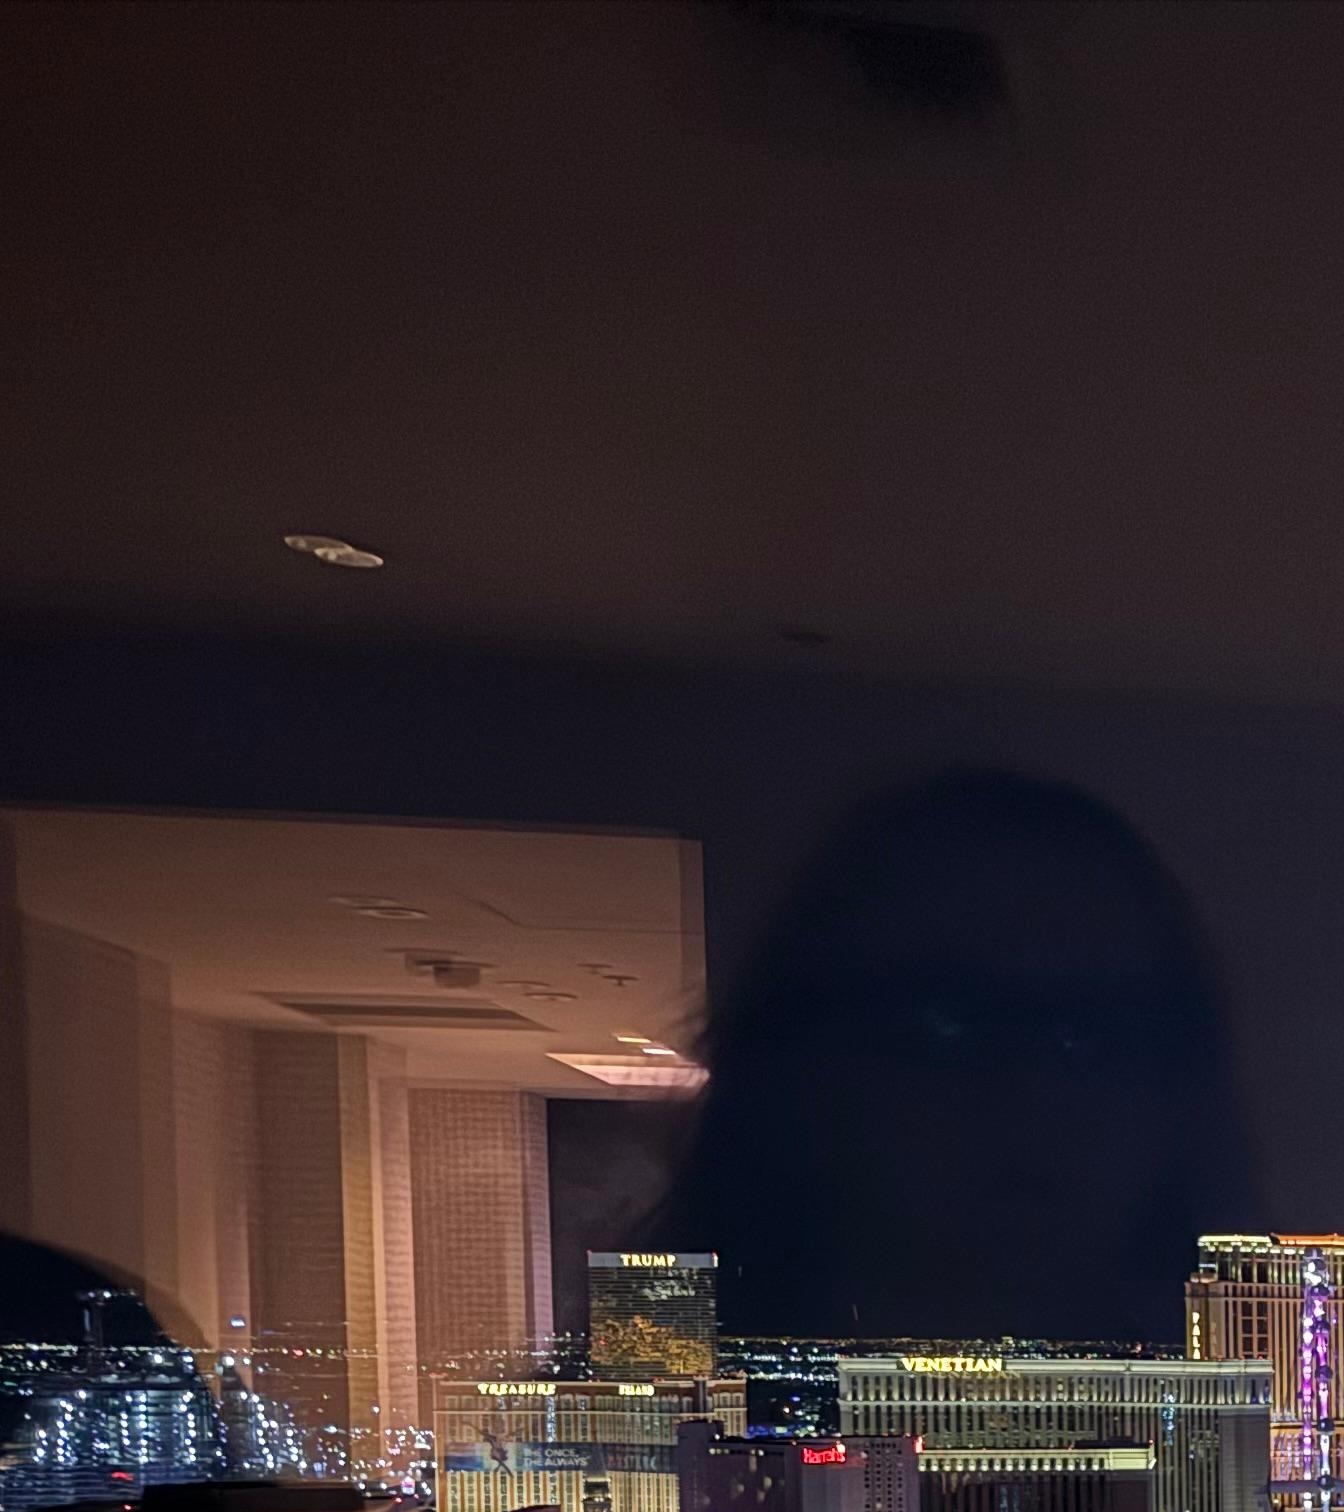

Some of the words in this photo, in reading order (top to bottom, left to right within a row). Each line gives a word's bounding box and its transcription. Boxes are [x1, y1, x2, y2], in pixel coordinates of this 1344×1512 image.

[620, 1254, 676, 1267] TRUMP
[901, 1356, 1003, 1372] VENETIAN
[477, 1383, 556, 1395] TREASURE
